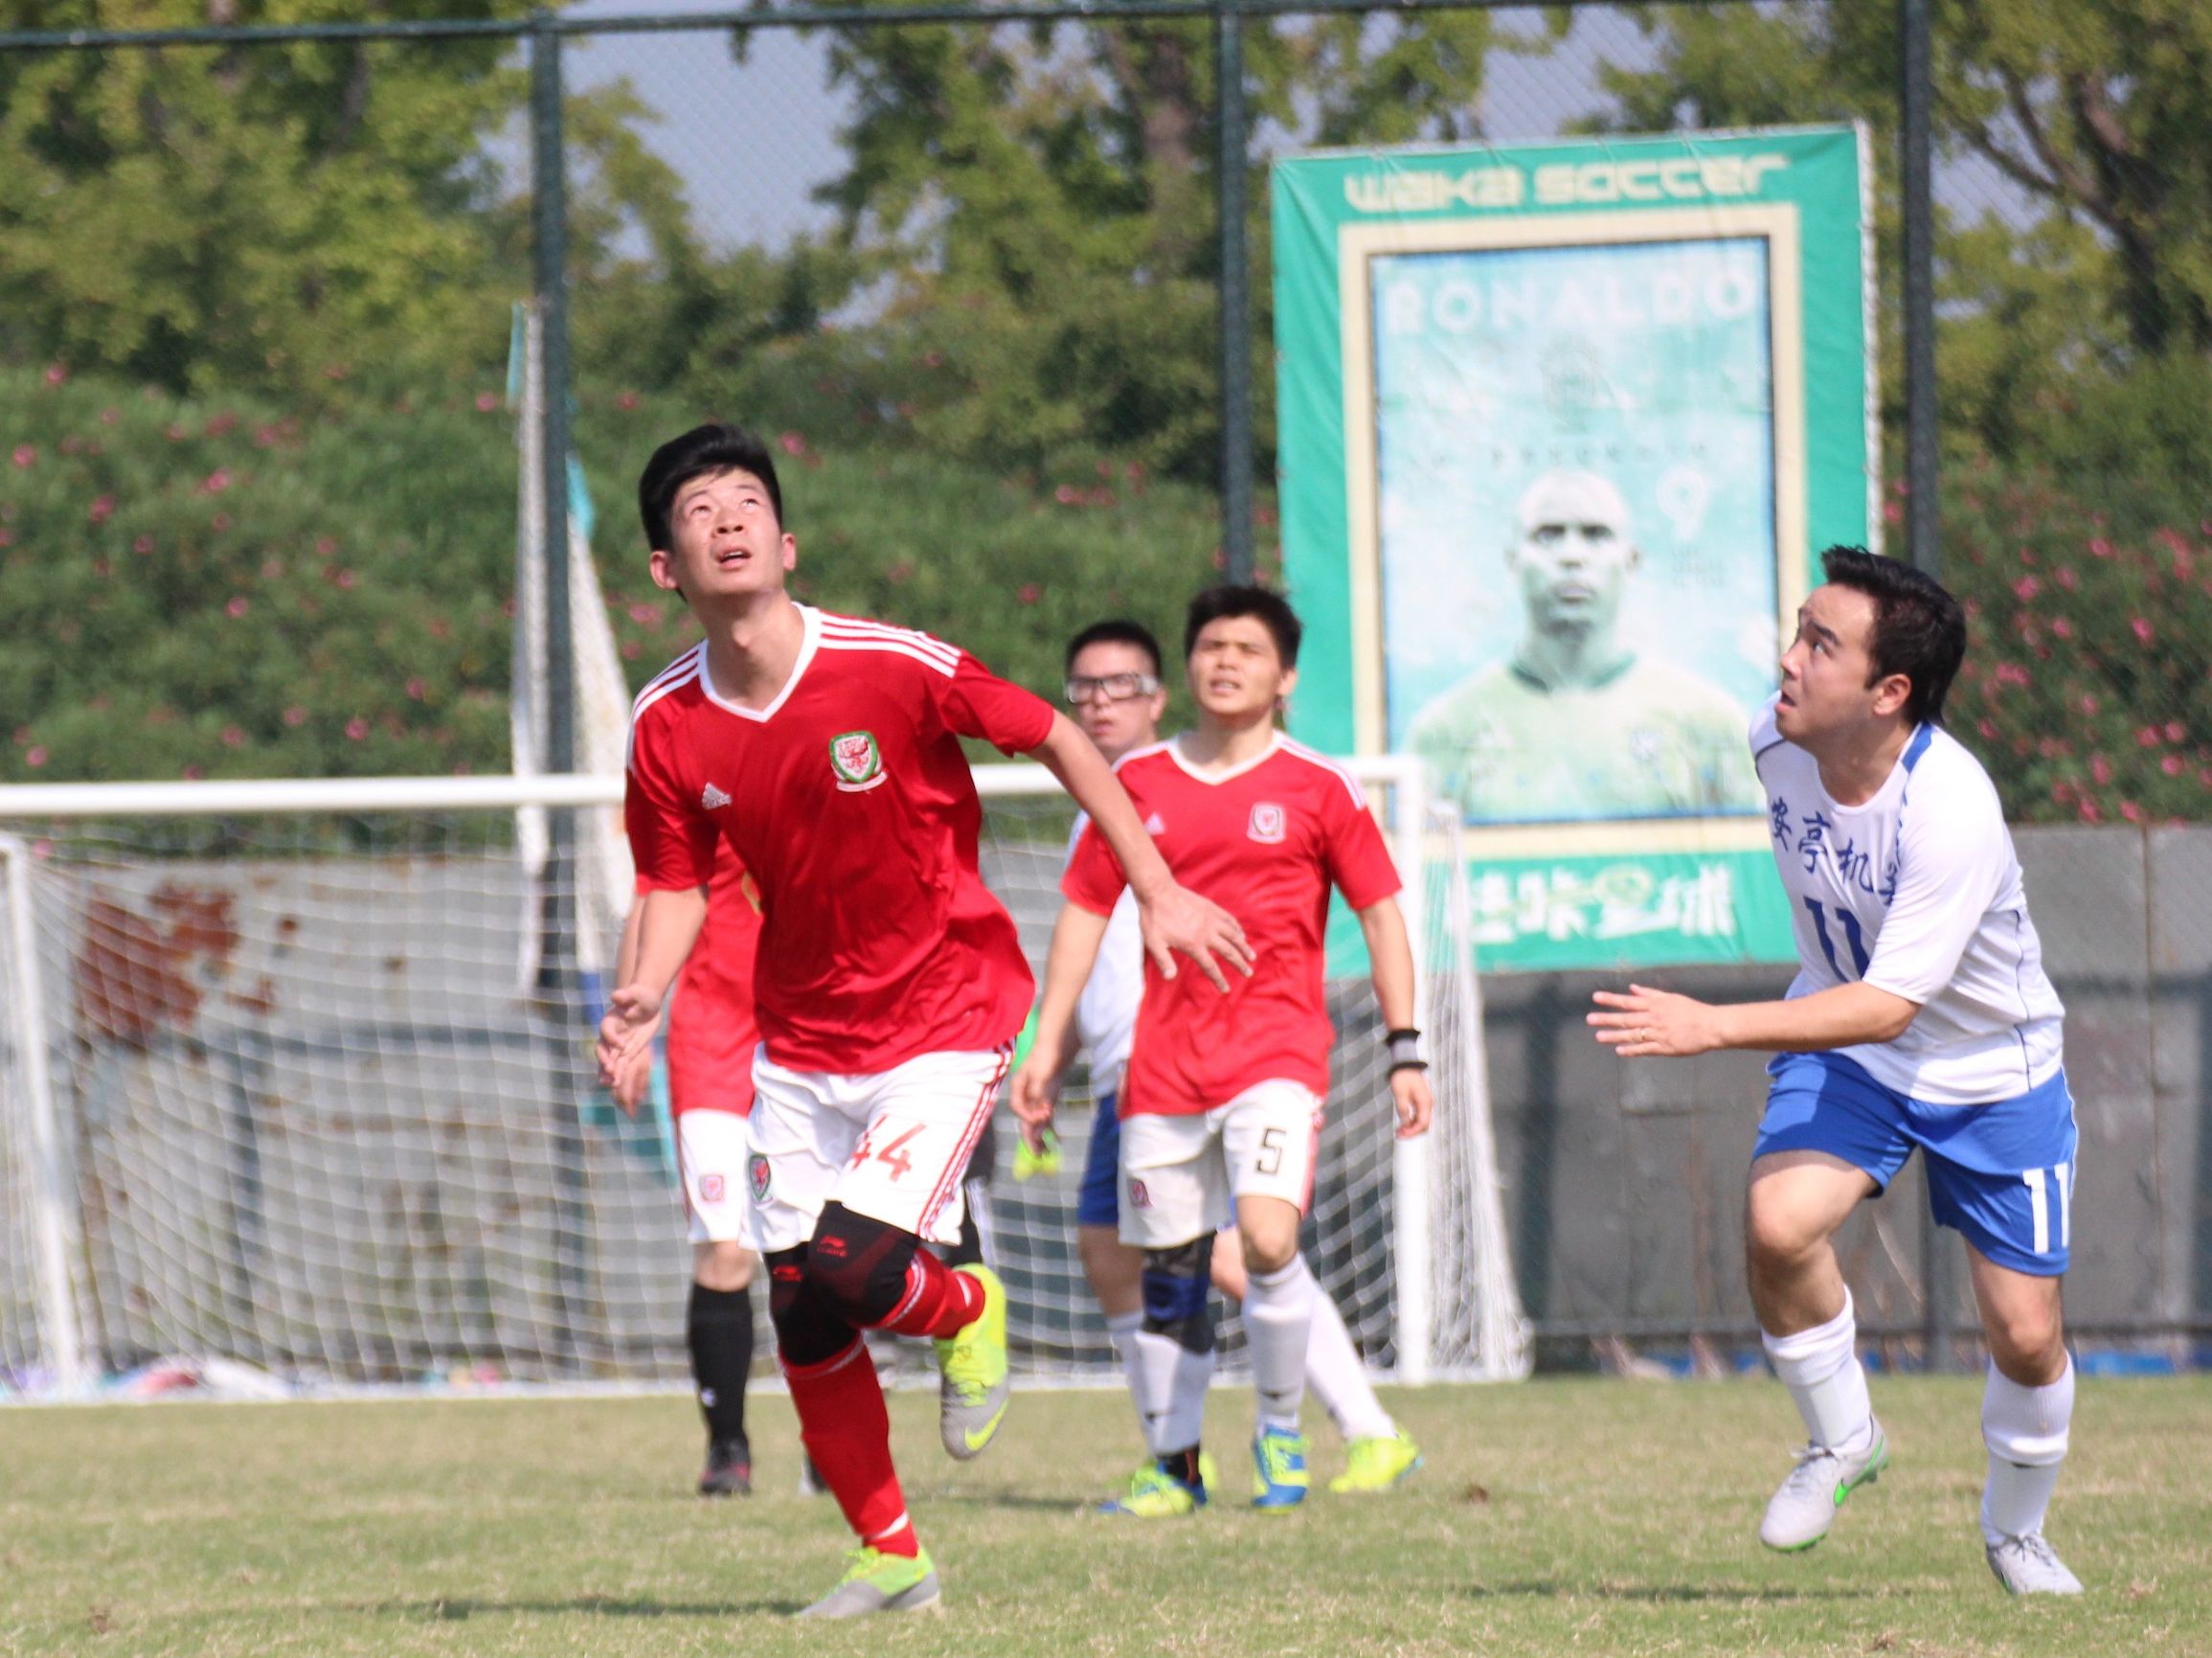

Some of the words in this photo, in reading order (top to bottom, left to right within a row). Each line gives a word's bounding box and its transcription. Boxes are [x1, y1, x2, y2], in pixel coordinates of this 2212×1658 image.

[1385, 271, 1756, 334] RONALDO
[1655, 466, 1710, 542] 9
[1803, 895, 1870, 984] 11
[1255, 1127, 1287, 1175] 5
[2022, 1161, 2068, 1254] 11
